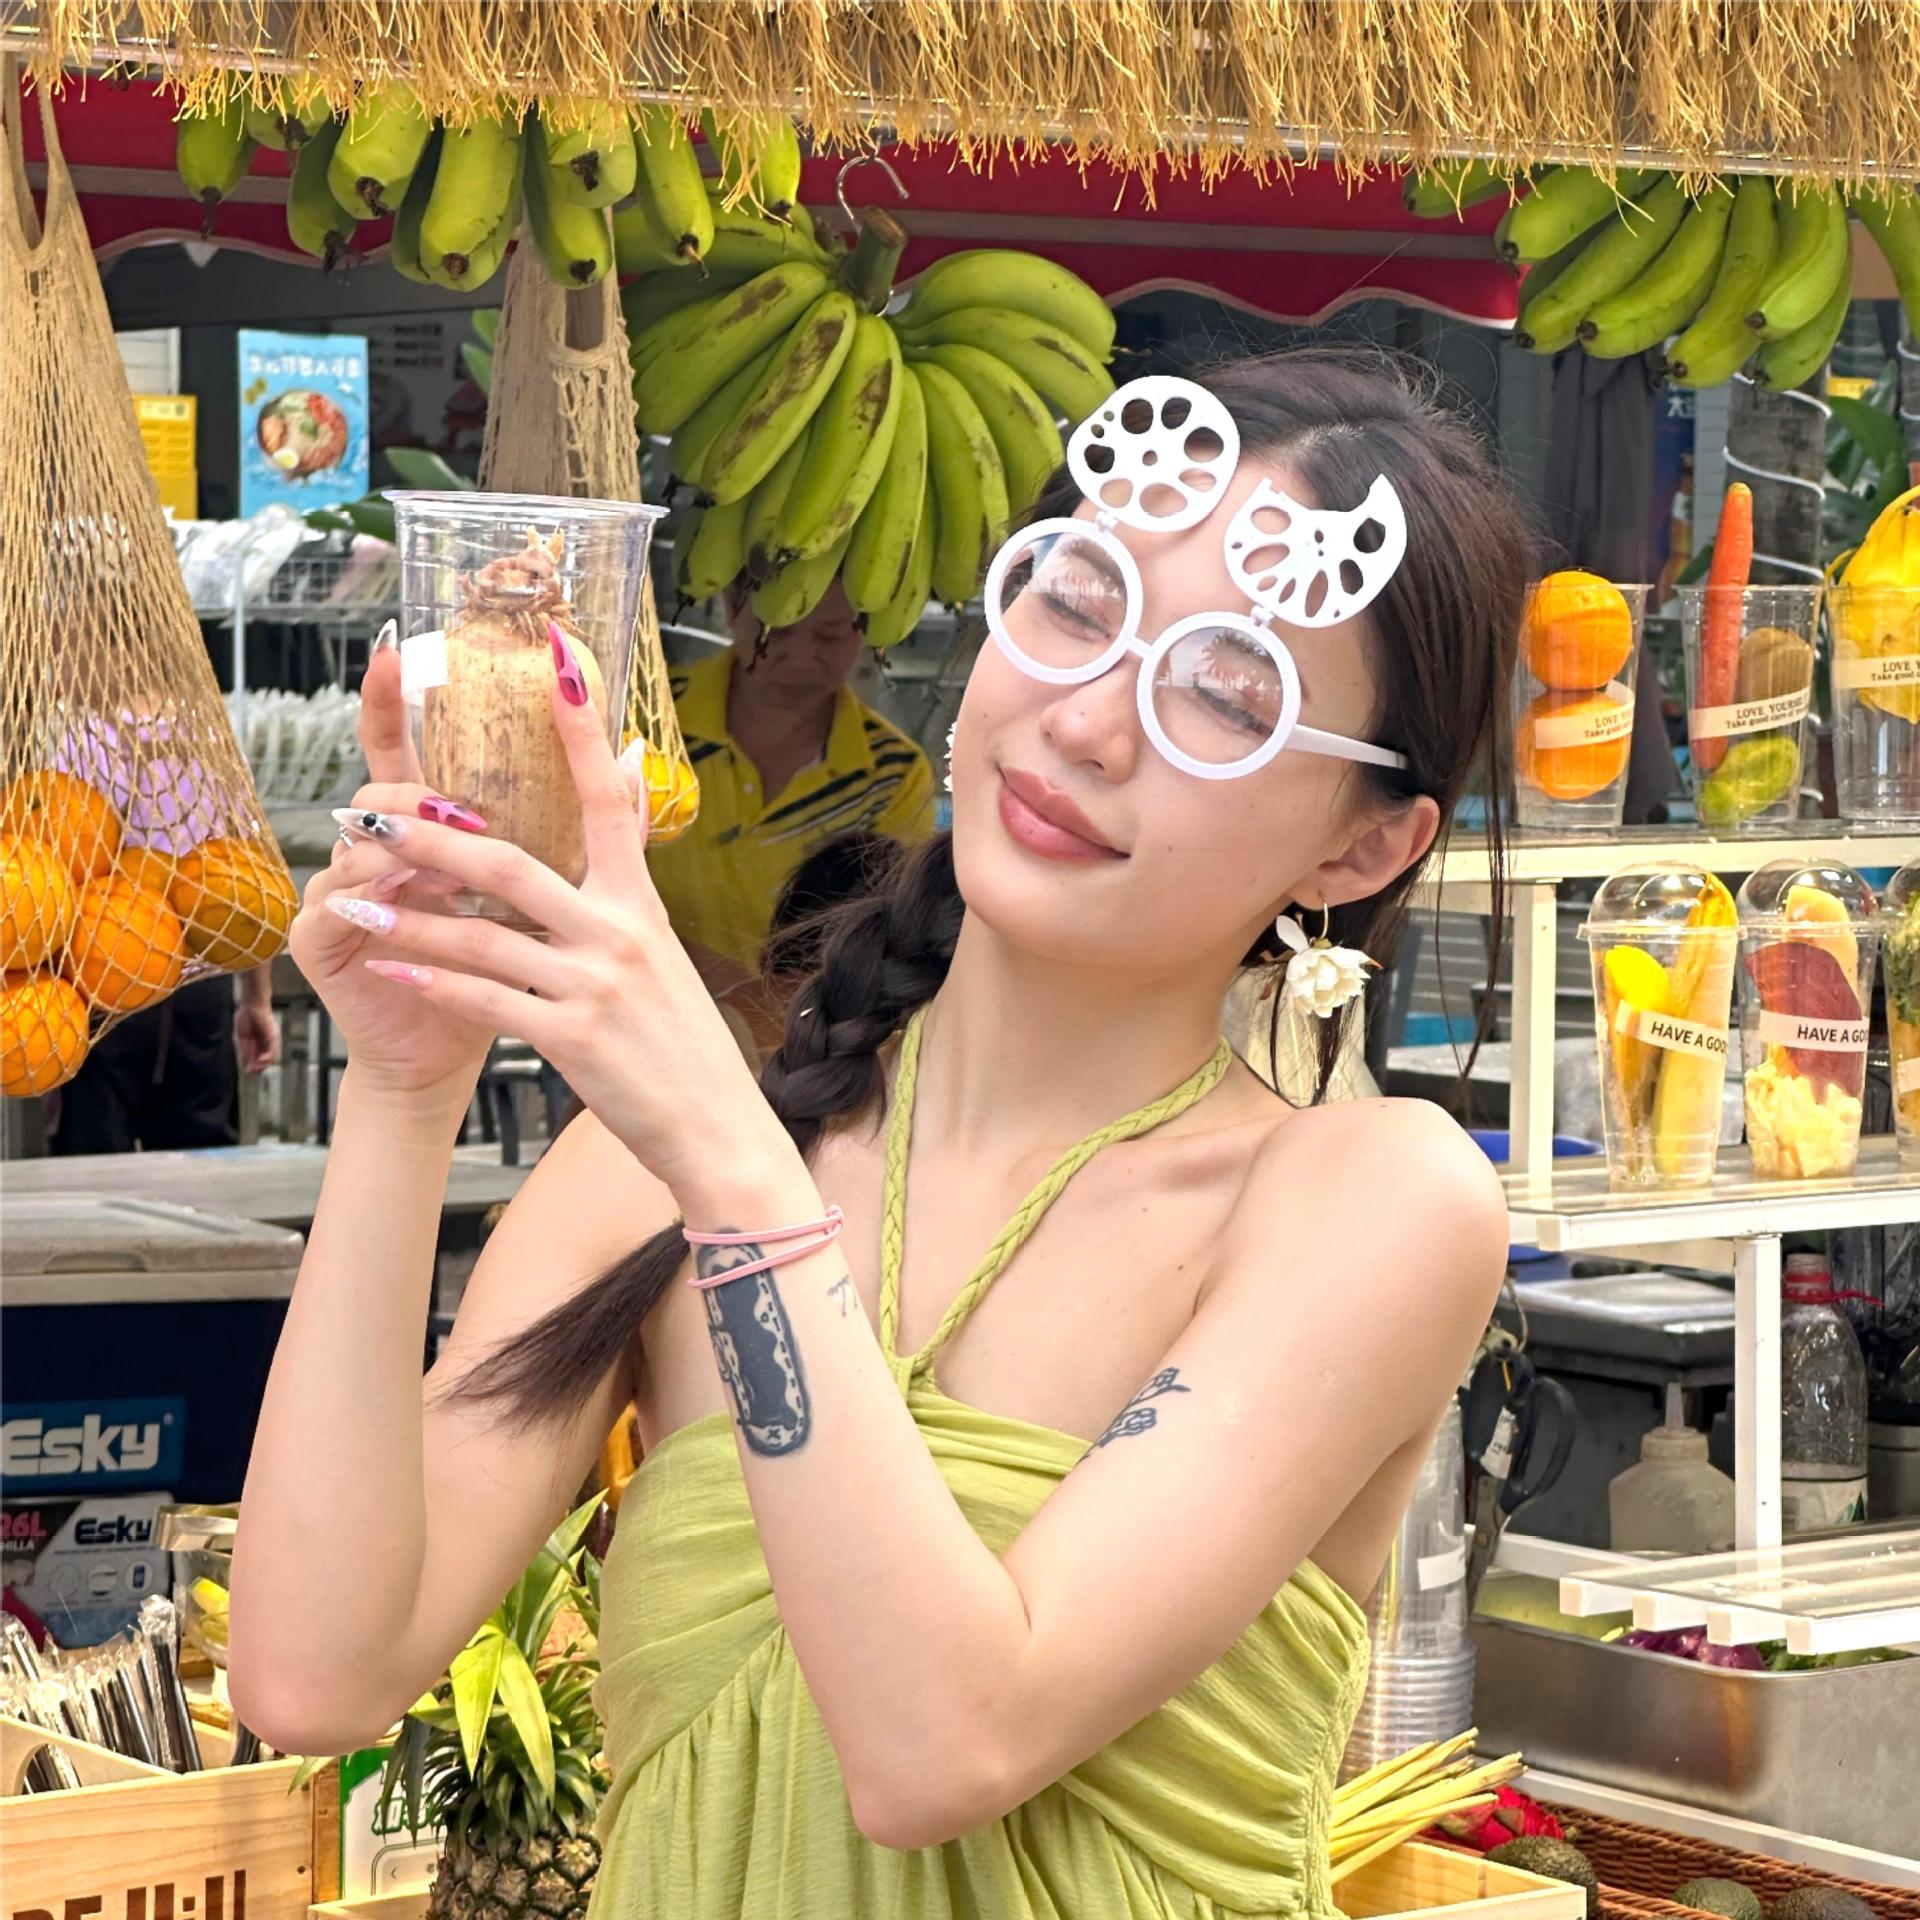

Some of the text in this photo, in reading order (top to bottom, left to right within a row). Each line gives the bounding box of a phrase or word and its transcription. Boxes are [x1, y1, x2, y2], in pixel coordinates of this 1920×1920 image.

[1882, 660, 1912, 673] LOVE
[1736, 706, 1765, 720] LOVE
[1726, 718, 1746, 729] Take
[1651, 1021, 1693, 1044] HAVE
[1694, 1033, 1703, 1048] A
[1797, 1024, 1838, 1043] HAVE
[1840, 1029, 1849, 1043] A
[0, 1414, 160, 1477] Esky
[74, 1515, 152, 1545] Esky
